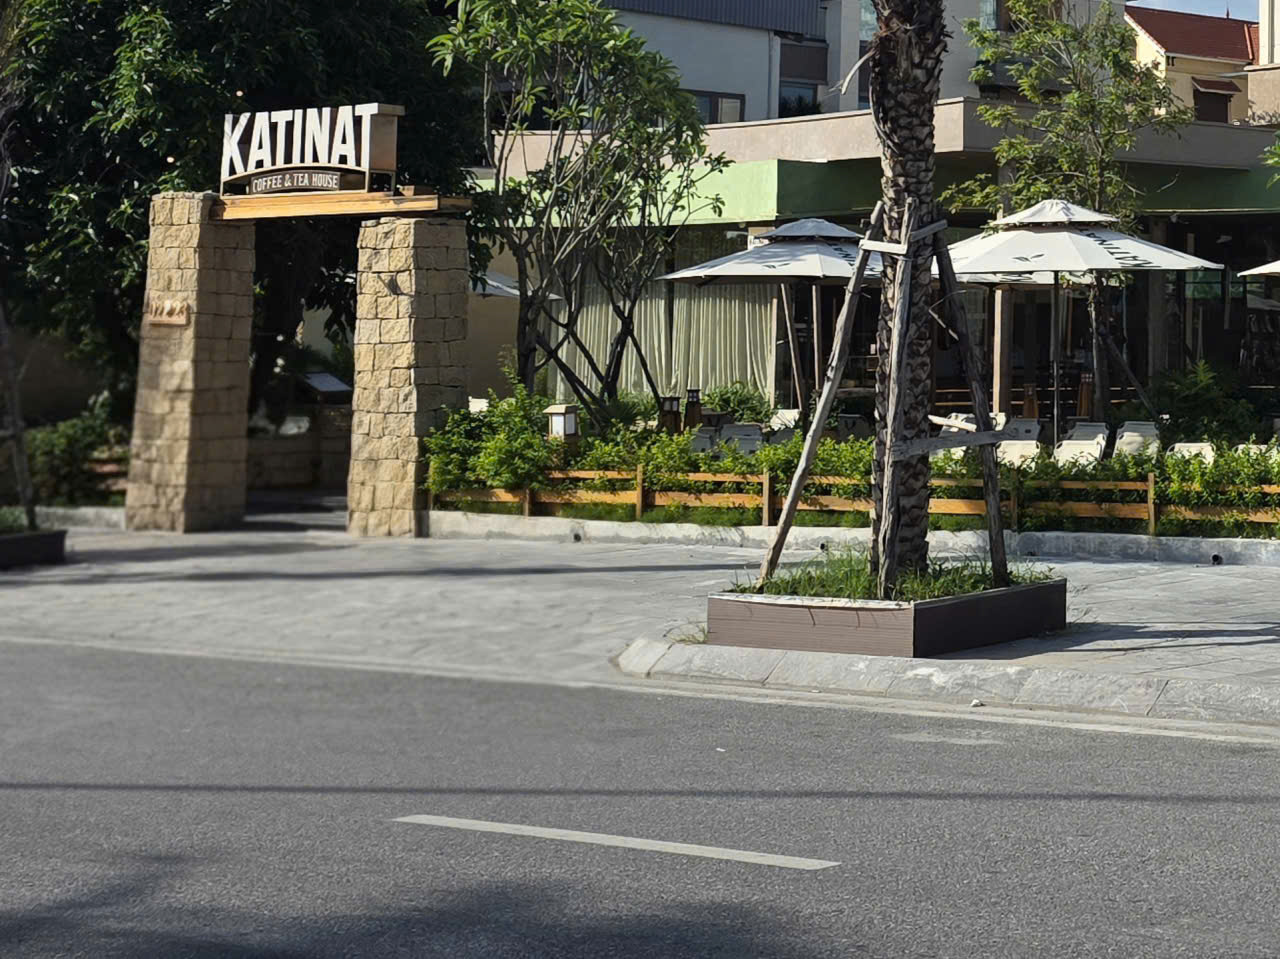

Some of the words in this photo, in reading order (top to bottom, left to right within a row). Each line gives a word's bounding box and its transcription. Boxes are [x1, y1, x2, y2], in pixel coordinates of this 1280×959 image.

[222, 102, 379, 181] KATINAT
[252, 174, 283, 193] COFFEE
[284, 174, 292, 187] &
[293, 173, 310, 187] TEA
[311, 173, 339, 189] HOUSE
